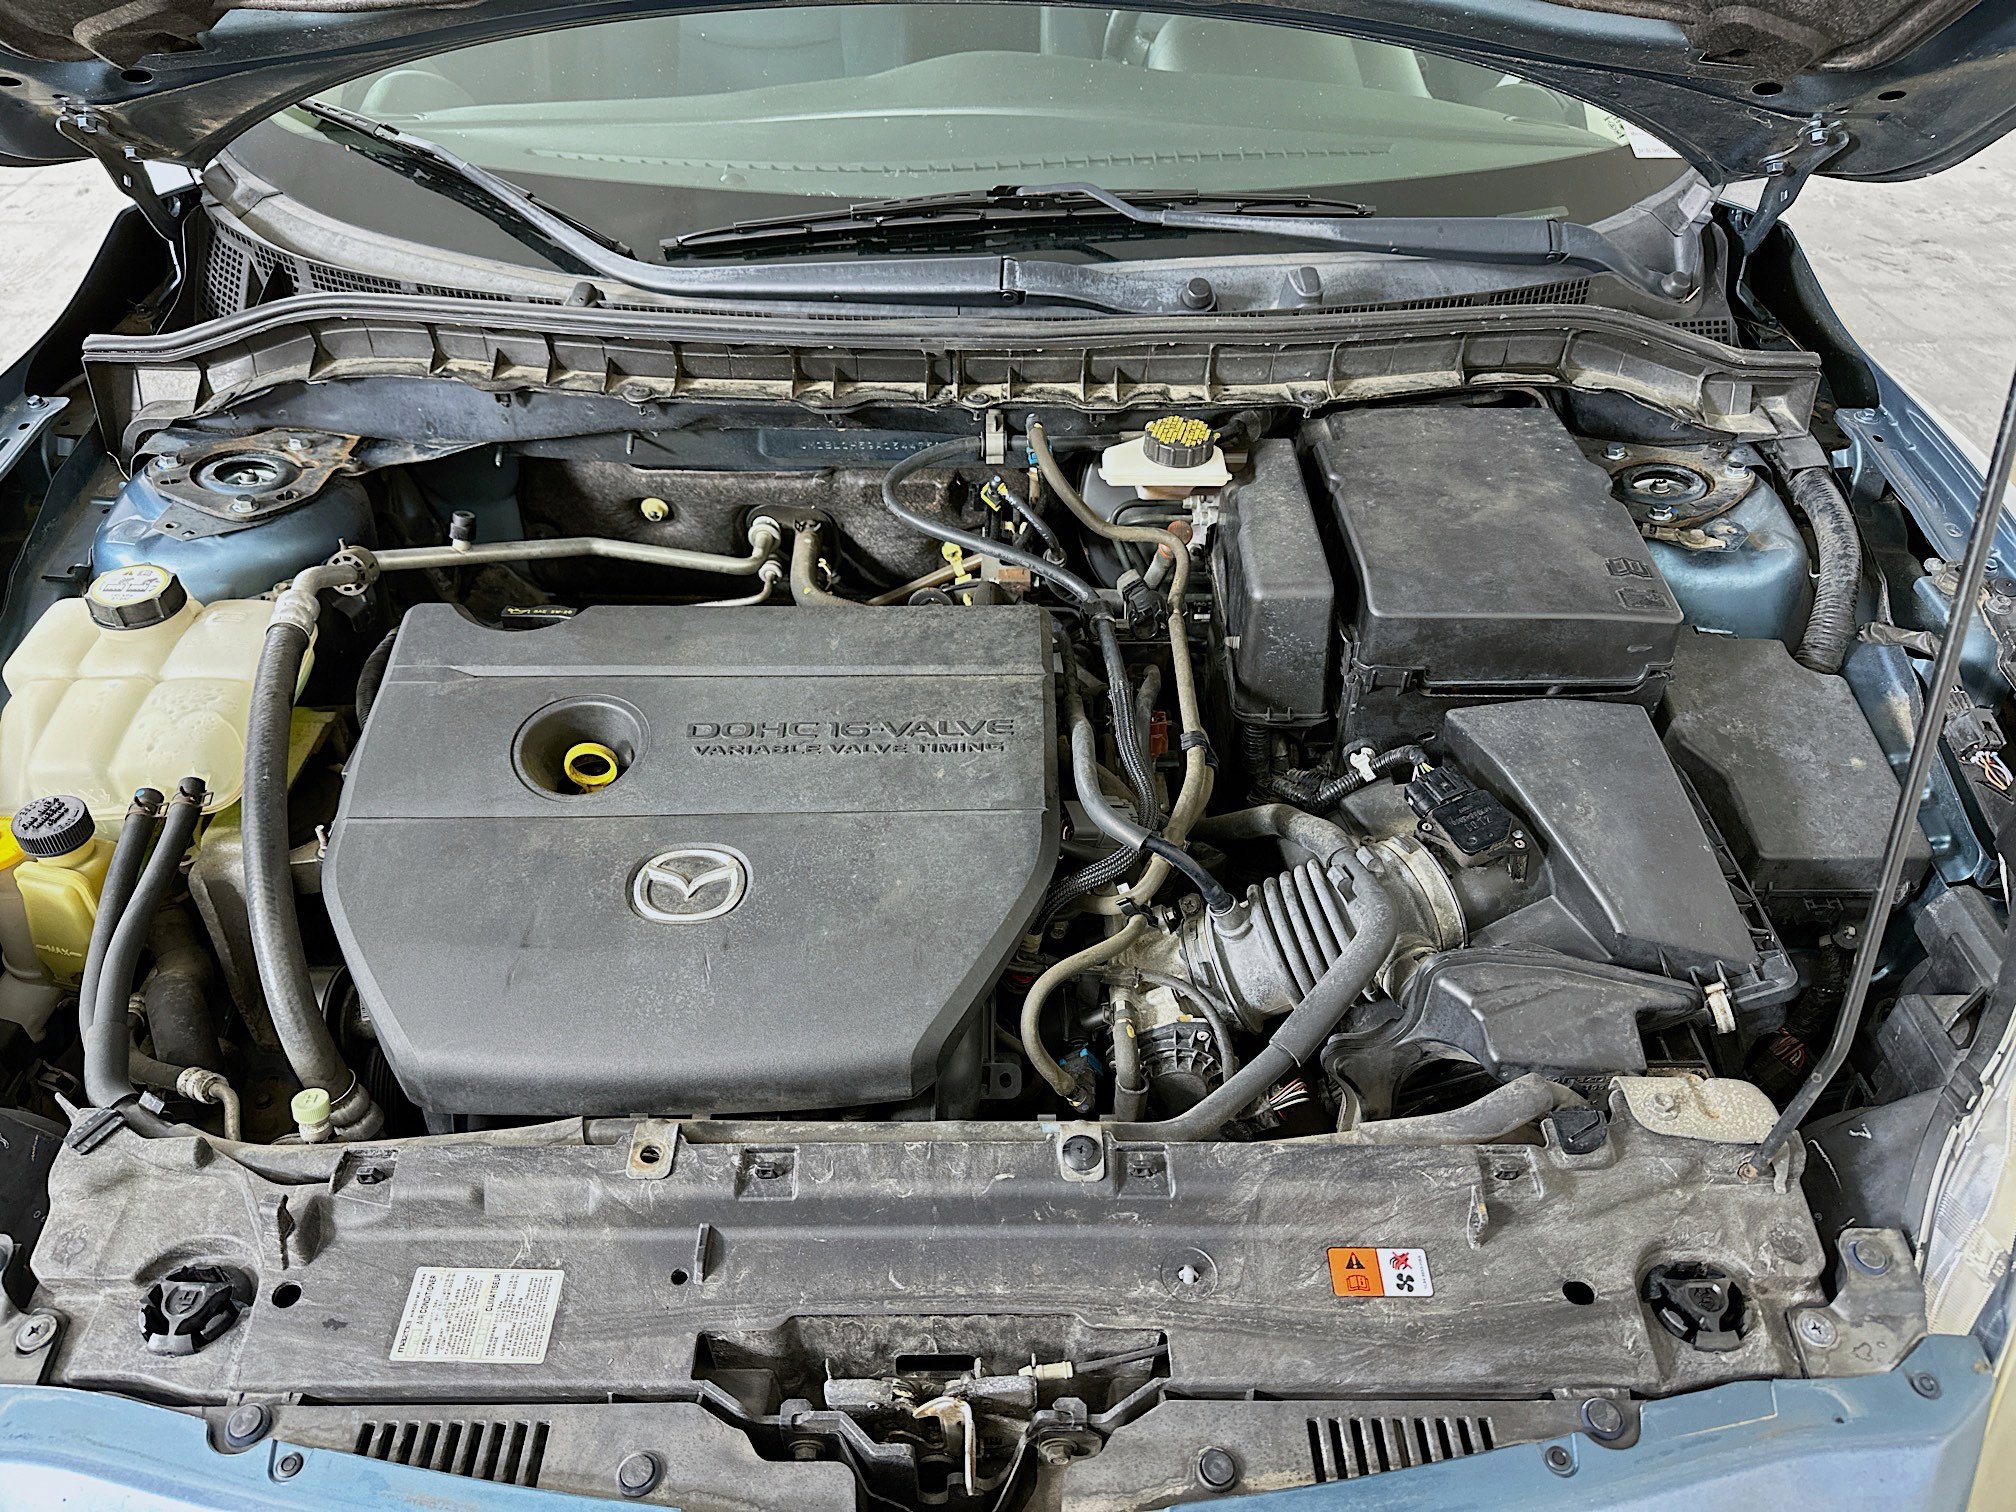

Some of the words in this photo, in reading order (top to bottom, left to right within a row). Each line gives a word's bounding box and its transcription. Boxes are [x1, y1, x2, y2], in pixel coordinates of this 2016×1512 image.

[686, 721, 820, 740] DOHC
[830, 718, 1016, 738] 16-VALVE
[693, 744, 822, 757] VARIABLE
[829, 743, 909, 755] VALVE
[916, 741, 1006, 753] TIMING
[419, 1275, 437, 1314] CONDITIONER
[485, 1273, 501, 1312] CLIMATISEUR
[416, 1314, 426, 1325] AIR
[397, 1320, 412, 1353] mazda
